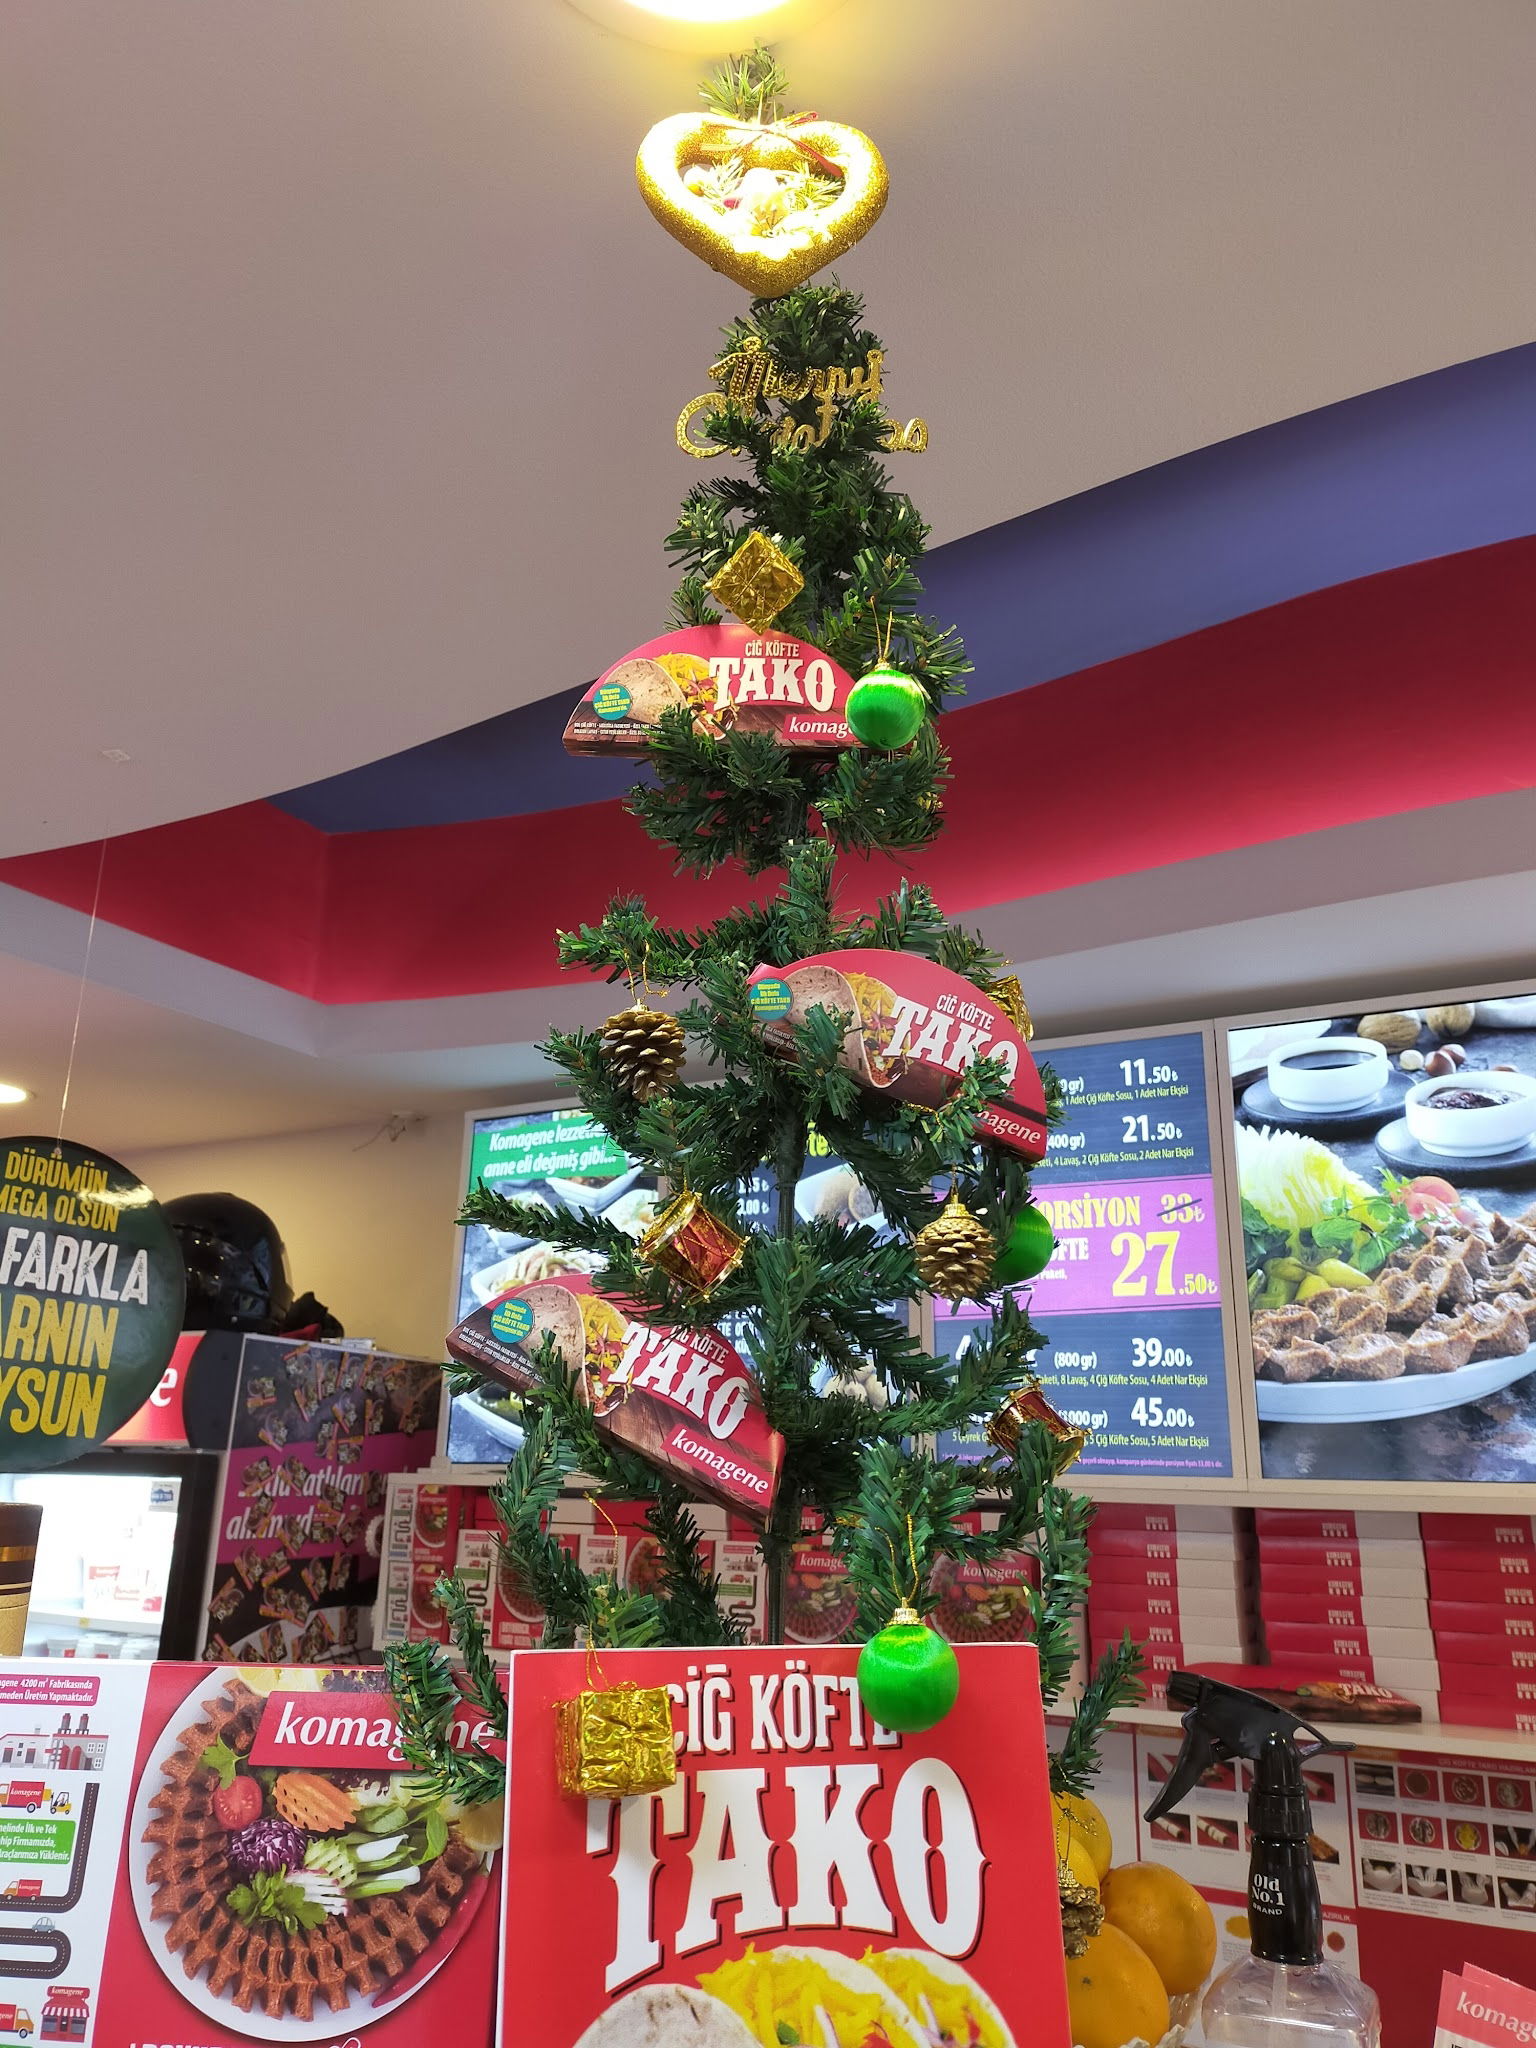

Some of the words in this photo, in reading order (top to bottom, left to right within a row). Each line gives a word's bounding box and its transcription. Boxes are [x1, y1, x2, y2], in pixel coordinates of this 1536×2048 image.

[766, 640, 800, 657] KÖFTE
[709, 656, 838, 713] TAKO
[789, 716, 854, 739] komag
[956, 1001, 995, 1031] KÖFTE
[882, 996, 1018, 1088] TAKO
[1070, 1094, 1086, 1105] Adet
[1086, 1093, 1097, 1106] Çiğ
[1098, 1092, 1116, 1103] Köfte
[1140, 1088, 1156, 1098] Adet
[1157, 1086, 1169, 1097] Nar
[1170, 1084, 1189, 1097] Ekşisi
[490, 1129, 554, 1152] Komagene
[977, 1110, 1041, 1144] agene
[483, 1160, 515, 1178] anne
[516, 1156, 533, 1174] eli
[533, 1149, 578, 1174] değmiş
[1082, 1154, 1086, 1164] 2
[1088, 1153, 1100, 1166] Çiğ
[1100, 1152, 1119, 1163] Köfte
[1139, 1150, 1144, 1159] 2
[1144, 1149, 1161, 1159] Adet
[1162, 1148, 1174, 1158] Nar
[1175, 1147, 1194, 1158] Ekşisi
[54, 1195, 119, 1233] OLSUN
[1035, 1192, 1140, 1230] ORSİYON
[0, 1227, 149, 1305] FARKLA
[0, 1294, 119, 1370] RNIN
[690, 1333, 730, 1364] KÖFTE
[608, 1320, 748, 1440] TAKO
[1060, 1376, 1066, 1385] 8
[1066, 1375, 1088, 1387] Lavaş,
[1090, 1375, 1095, 1384] 4
[1096, 1374, 1108, 1387] Çiğ
[1109, 1374, 1128, 1385] Köfte
[1150, 1374, 1156, 1384] 4
[1156, 1374, 1174, 1384] Adet
[1176, 1374, 1188, 1384] Nar
[1188, 1374, 1208, 1387] Ekşisi
[0, 1365, 106, 1438] YSUN
[1090, 1435, 1094, 1445] 5
[1096, 1434, 1108, 1448] Çiğ
[1109, 1434, 1128, 1446] Köfte
[1151, 1435, 1156, 1446] 5
[1157, 1434, 1174, 1446] Adet
[1176, 1436, 1188, 1446] Nar
[1189, 1436, 1208, 1449] Ekşisi
[670, 1428, 769, 1494] komagene
[800, 1553, 846, 1571] komage
[20, 1678, 38, 1688] 4200
[24, 1689, 48, 1700] Üretim
[1338, 1683, 1392, 1698] TAKO
[750, 1660, 898, 1750] KÖFT
[274, 1701, 495, 1762] komagne
[45, 1824, 58, 1834] Tek
[586, 1758, 988, 1994] TAKO
[1254, 1874, 1280, 1892] Old
[1252, 1903, 1282, 1916] BRAND
